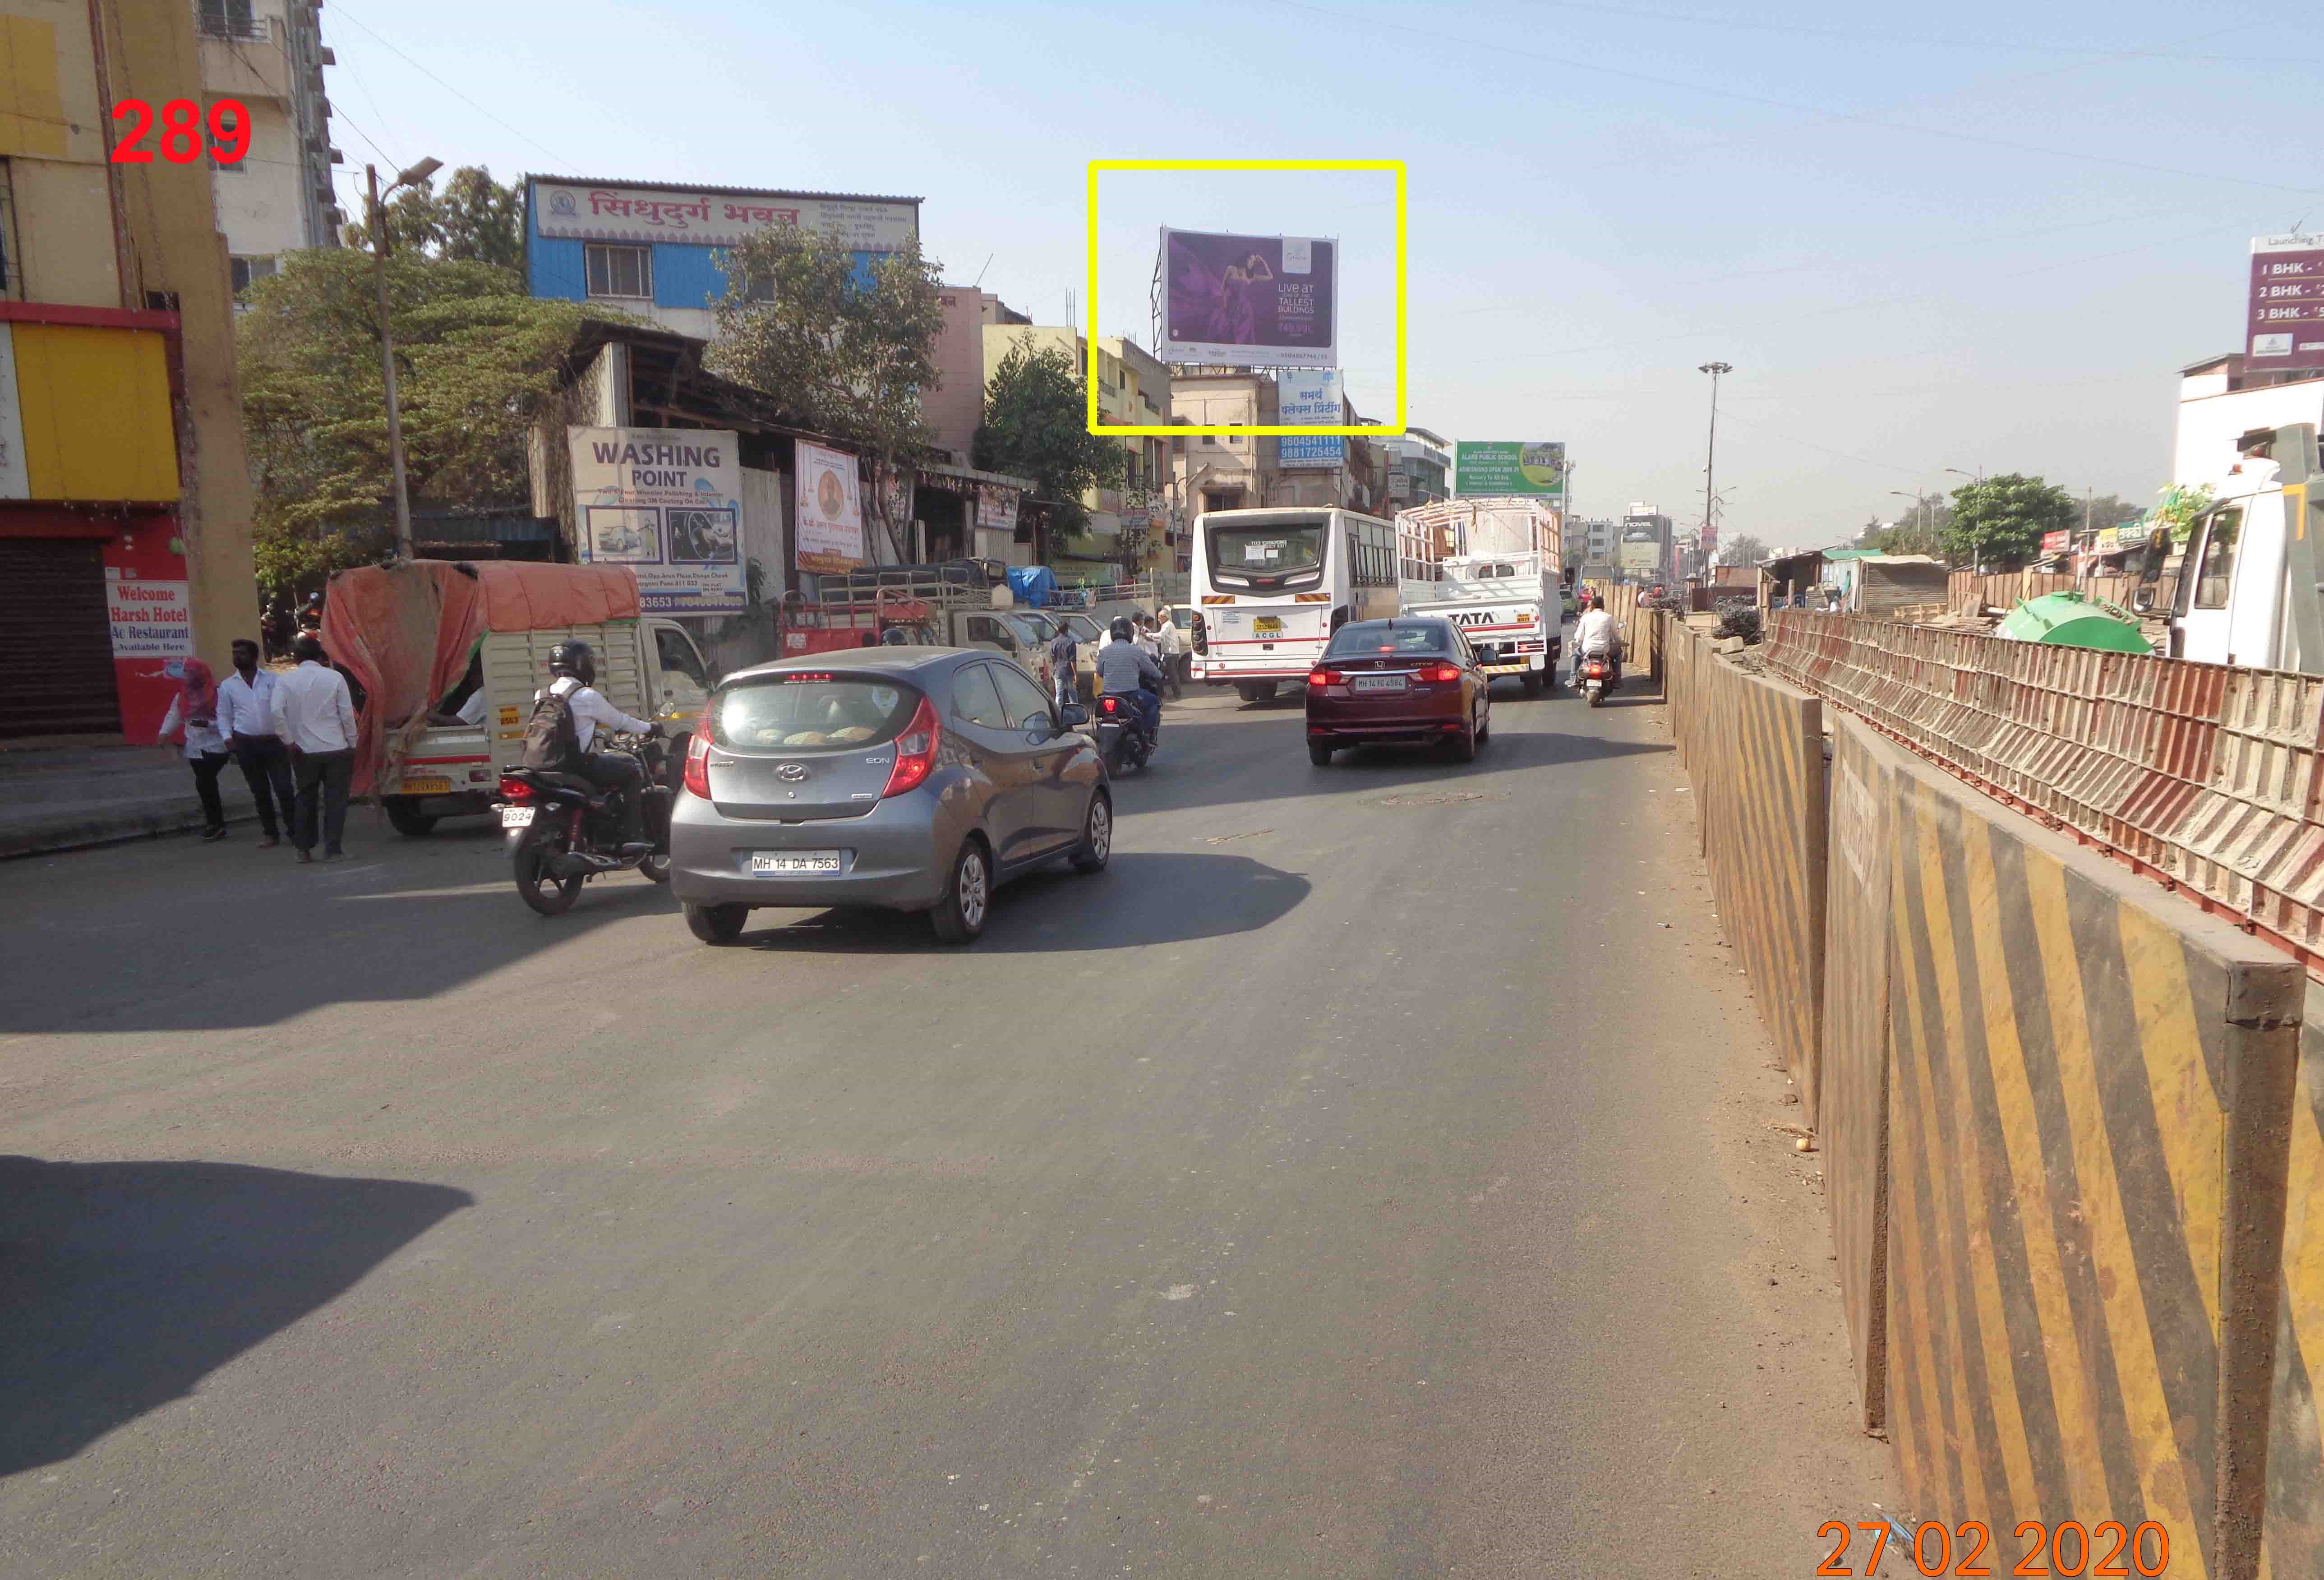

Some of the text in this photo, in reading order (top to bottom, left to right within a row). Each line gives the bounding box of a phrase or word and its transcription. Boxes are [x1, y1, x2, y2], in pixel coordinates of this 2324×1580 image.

[588, 190, 800, 228] सिंधुदुर्ग भवन
[2269, 235, 2313, 246] Launching
[2273, 263, 2304, 274] BHK
[2259, 286, 2268, 298] 2
[2270, 284, 2302, 296] BHK
[1277, 297, 1314, 307] TALLEST
[1277, 305, 1314, 314] BUILDINGS
[2257, 308, 2265, 320] 3
[2269, 307, 2301, 318] BHK
[592, 441, 720, 468] WASHING
[632, 470, 687, 487] POINT
[117, 584, 175, 601] Welcome
[639, 596, 672, 608] 83653
[111, 606, 188, 622] Harsh Hotel
[1448, 612, 1494, 625] TATA
[129, 625, 189, 639] Restaurant
[754, 858, 838, 869] MH 14 DA 7563
